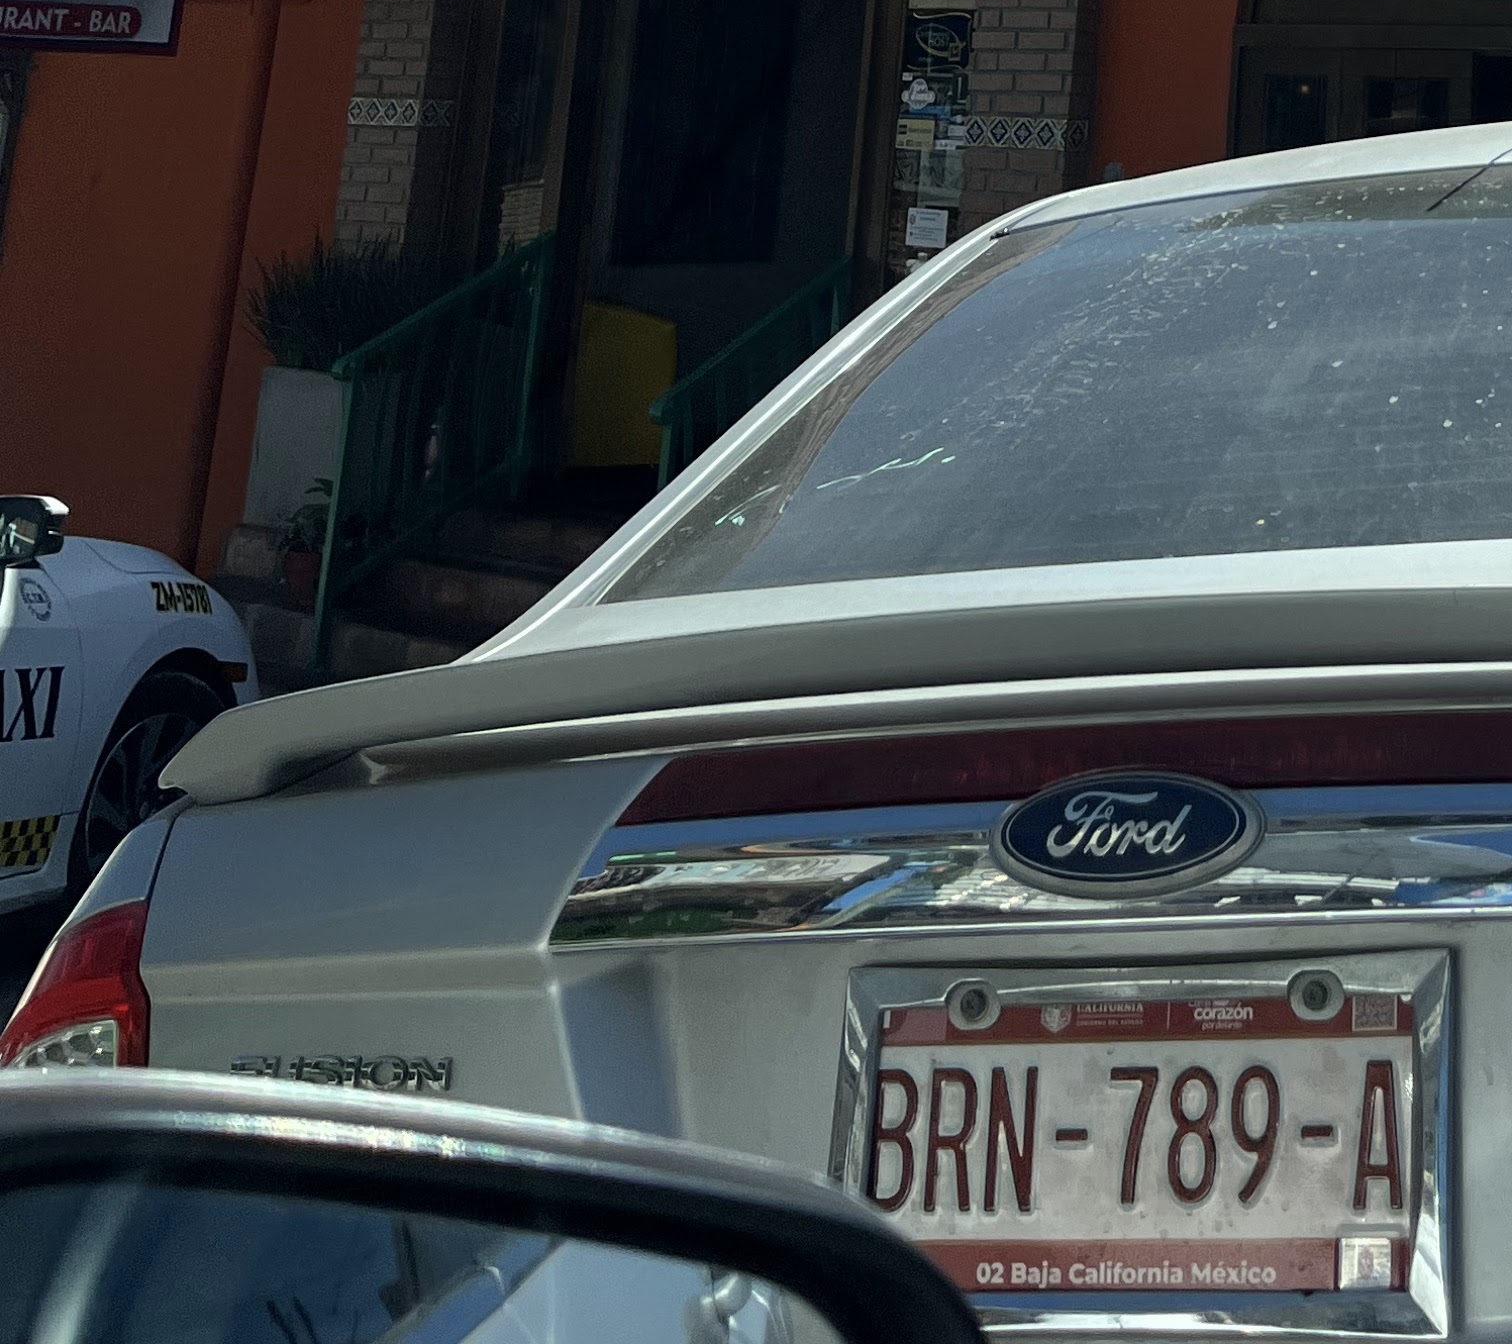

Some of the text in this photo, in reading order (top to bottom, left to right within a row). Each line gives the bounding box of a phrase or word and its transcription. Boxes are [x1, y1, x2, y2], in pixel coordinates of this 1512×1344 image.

[0, 6, 69, 32] RANT
[89, 10, 131, 33] BAR
[1046, 791, 1193, 858] Ford
[1193, 1001, 1254, 1021] corazón
[872, 1059, 1403, 1213] BRN-789-A
[976, 1261, 1278, 1289] 02 Baja California México
